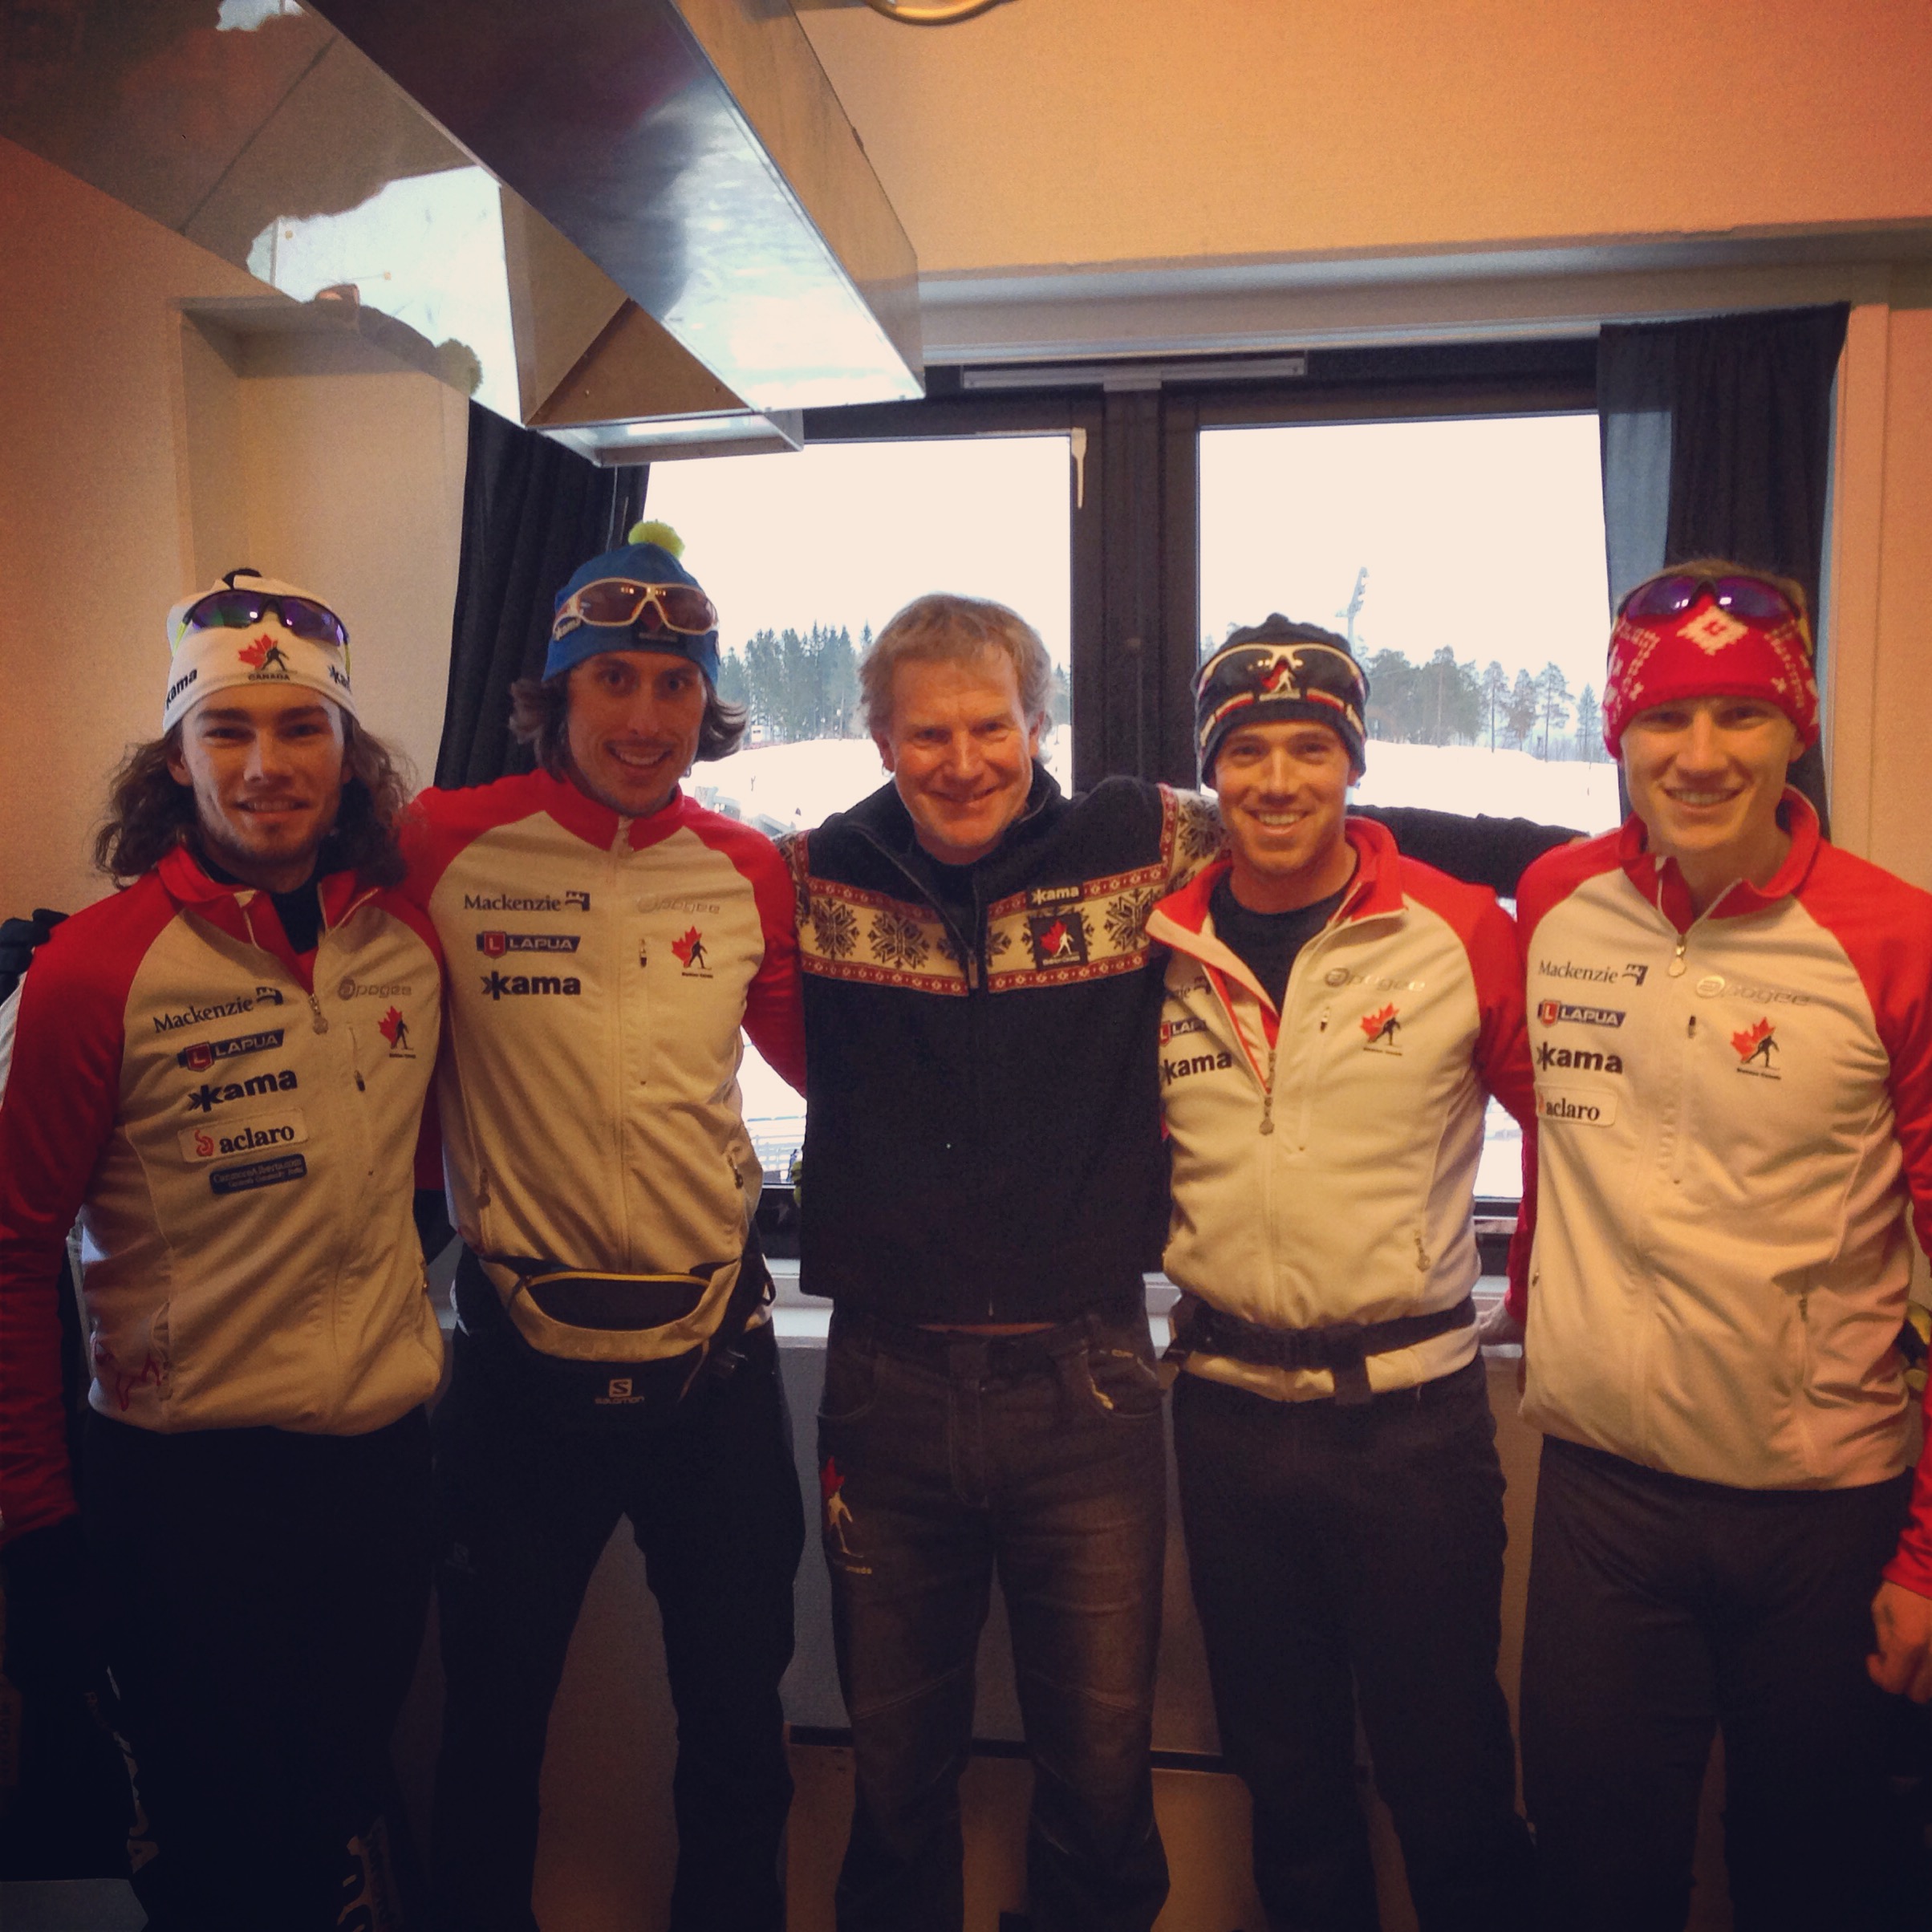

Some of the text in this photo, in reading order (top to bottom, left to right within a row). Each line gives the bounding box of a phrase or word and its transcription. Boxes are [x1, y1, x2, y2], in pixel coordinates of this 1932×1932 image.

[166, 668, 197, 710] kama
[248, 672, 290, 682] CANADA
[465, 894, 561, 912] Mackenzie
[1032, 887, 1079, 905] kama
[509, 937, 574, 951] LAPUA
[1539, 960, 1618, 984] Mackenzie
[481, 971, 581, 1000] kama
[153, 995, 254, 1033] Mackenzie
[1560, 1007, 1621, 1027] LAPUA
[214, 1033, 279, 1058] LAPUA
[1536, 1041, 1624, 1074] kama
[1163, 1052, 1233, 1085] kama
[189, 1070, 298, 1112] kama
[1545, 1099, 1601, 1122] aclaro
[219, 1125, 295, 1155] aclaro
